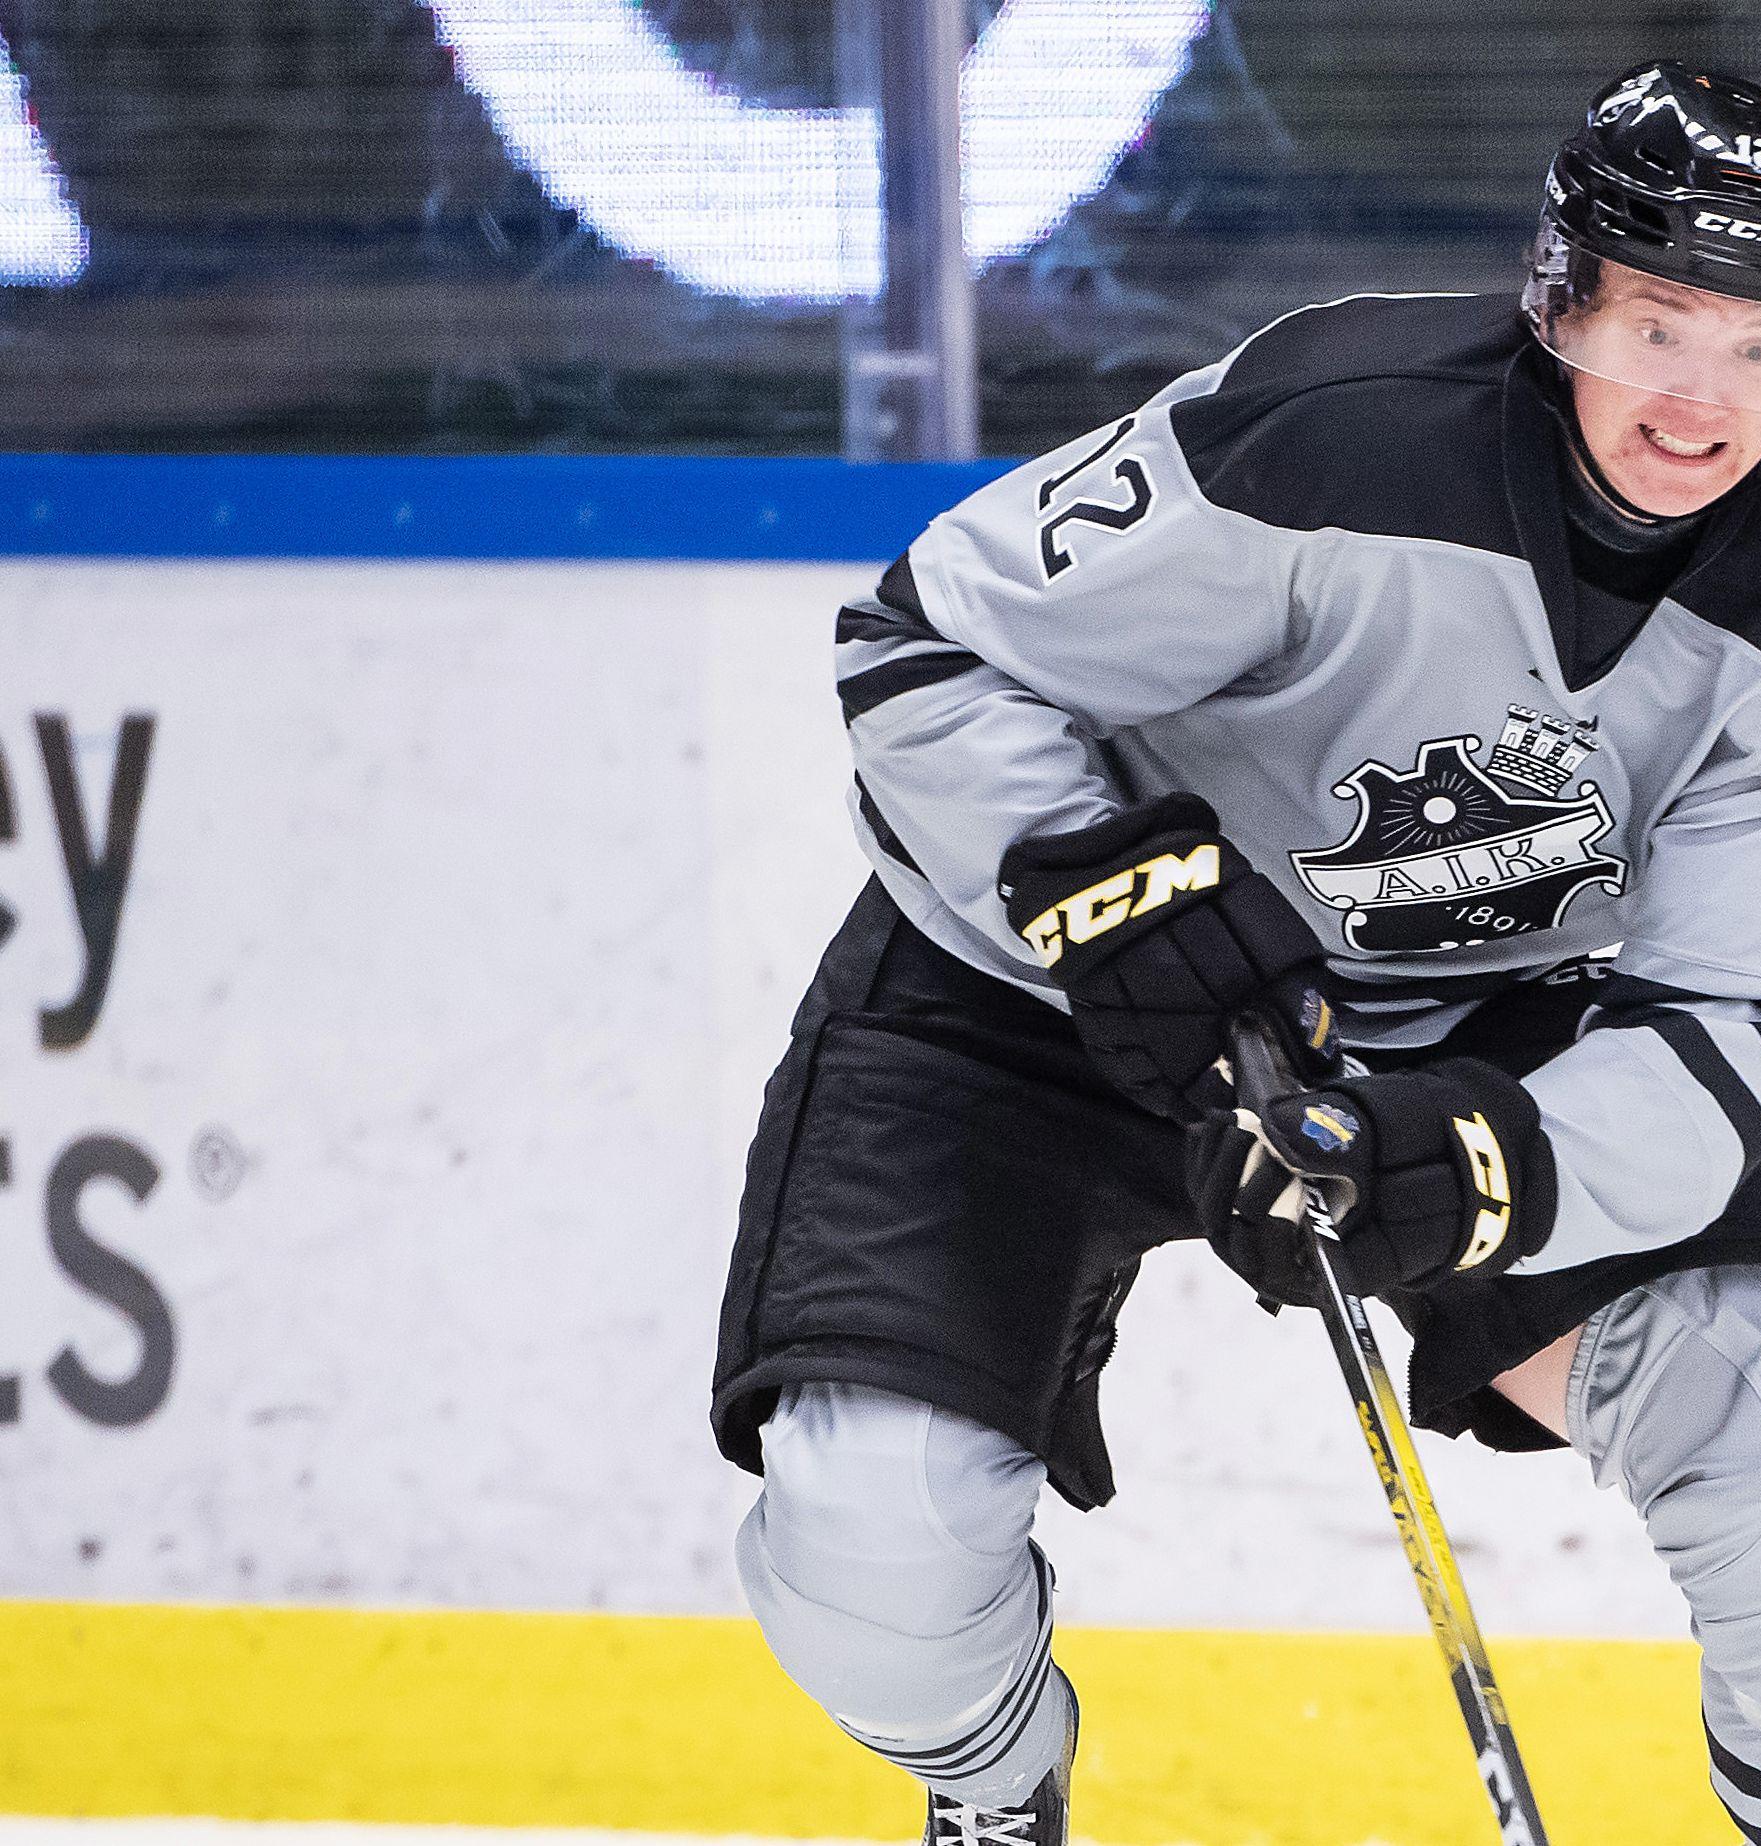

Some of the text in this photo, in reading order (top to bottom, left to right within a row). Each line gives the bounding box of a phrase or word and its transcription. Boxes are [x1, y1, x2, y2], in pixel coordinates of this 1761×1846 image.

[1036, 413, 1158, 585] 12
[0, 712, 157, 1054] y
[1020, 844, 1222, 970] CCM
